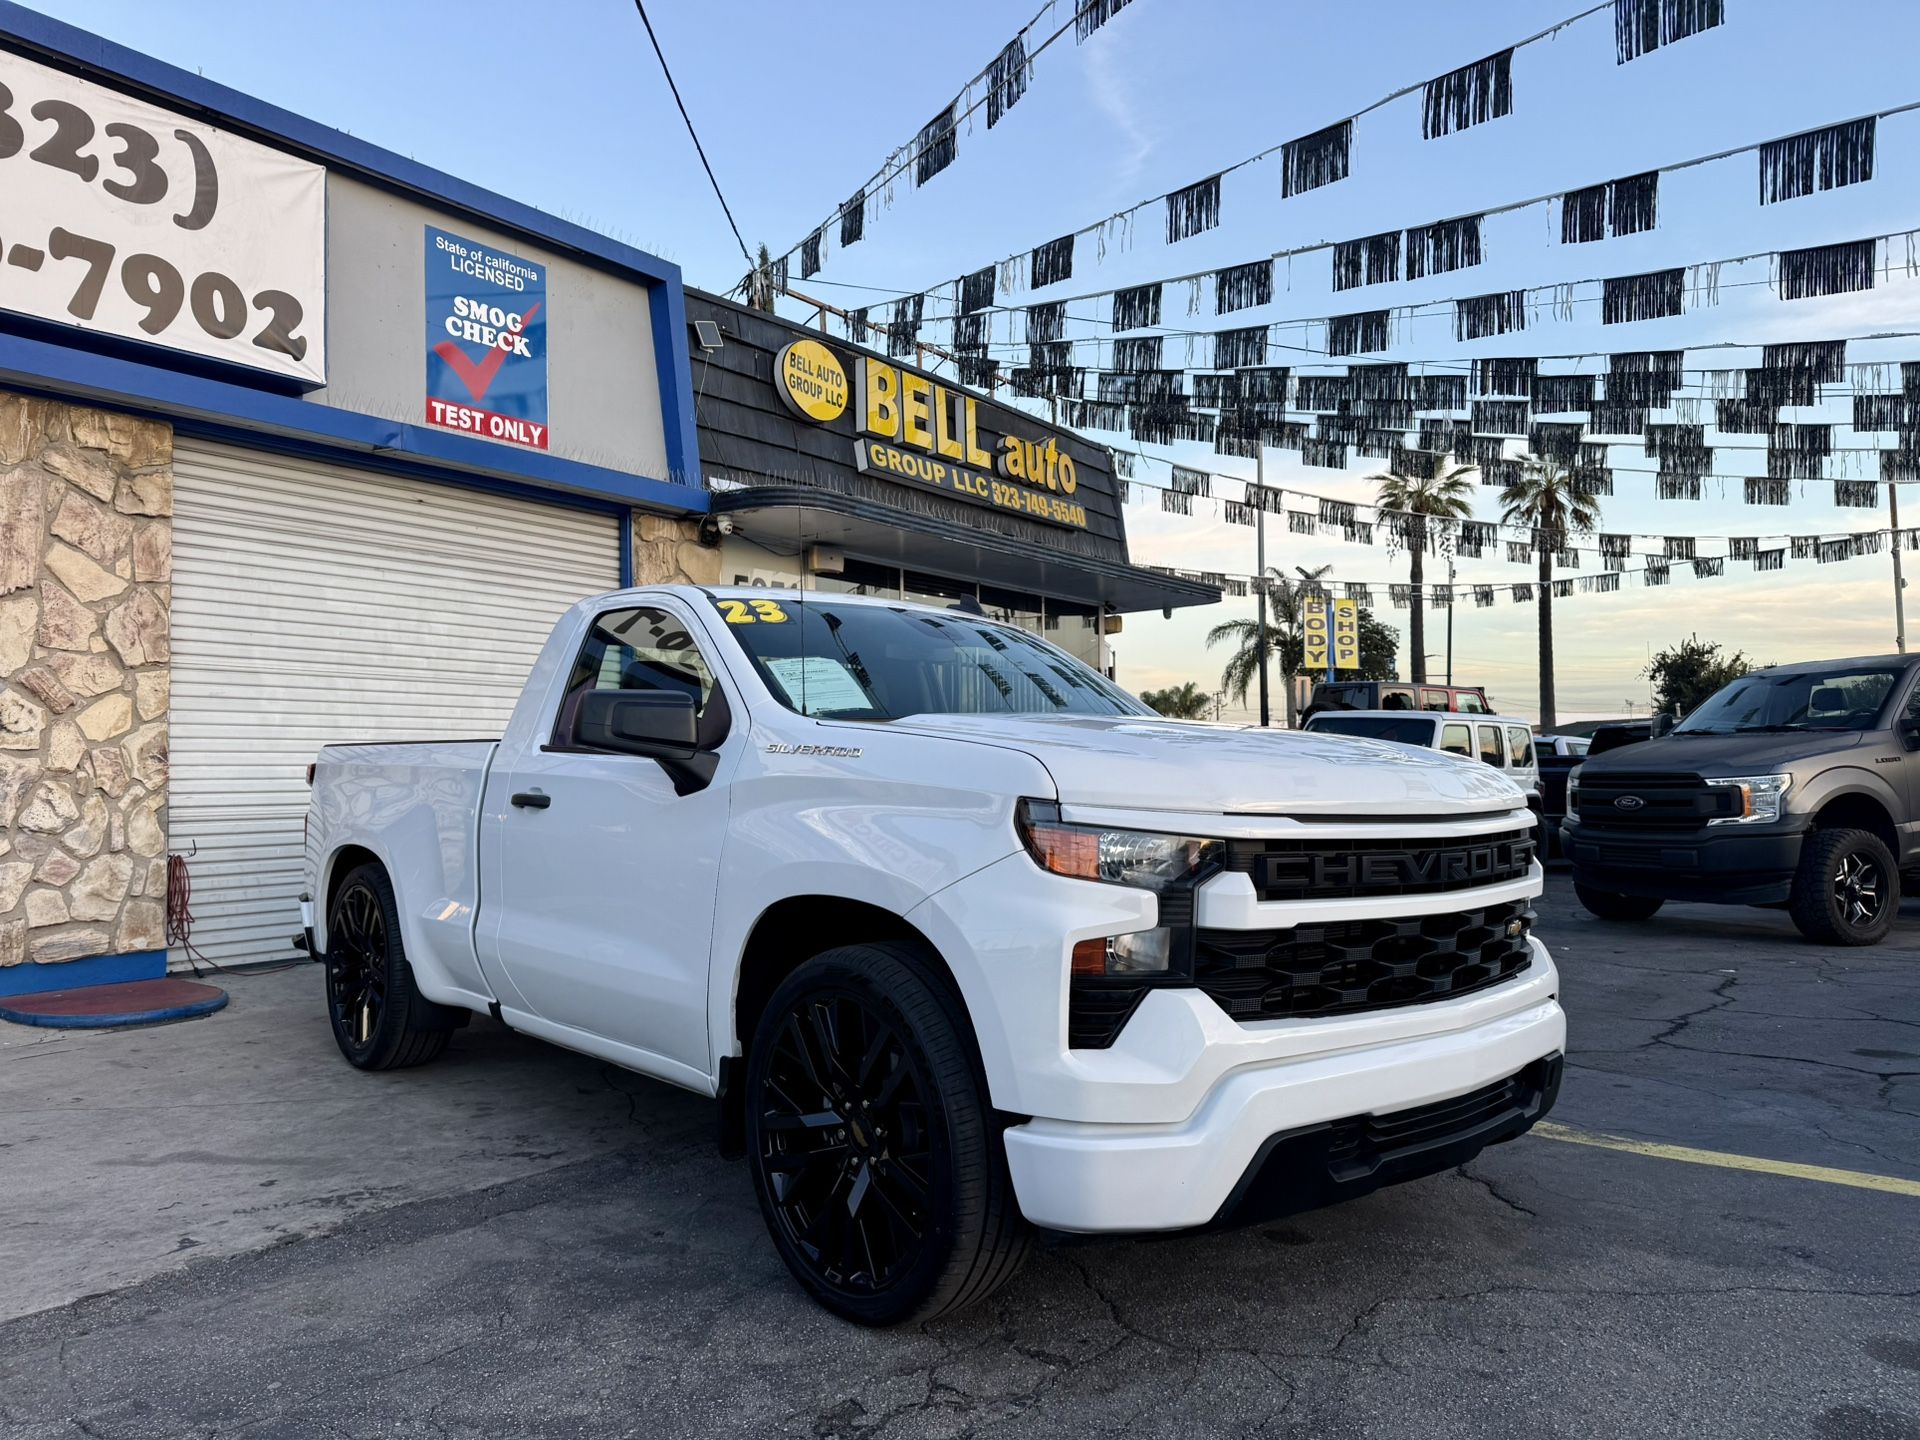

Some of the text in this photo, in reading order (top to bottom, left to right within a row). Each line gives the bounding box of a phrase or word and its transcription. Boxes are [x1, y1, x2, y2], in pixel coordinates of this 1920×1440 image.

[436, 236, 538, 282] State of california
[450, 255, 524, 292] LICENSED
[0, 226, 307, 362] -7902
[453, 295, 523, 333] SMOG
[445, 316, 532, 358] CHECK
[789, 373, 843, 408] GROUP LLC
[790, 352, 842, 388] BELL AUTO
[431, 401, 543, 446] TEST ONLY
[865, 356, 1078, 495] BELL auto
[870, 444, 1087, 528] GROUP LLC 323-749-5540
[717, 600, 788, 624] 23
[1306, 602, 1355, 663] BODY SHOP
[765, 743, 863, 758] SILVERADO
